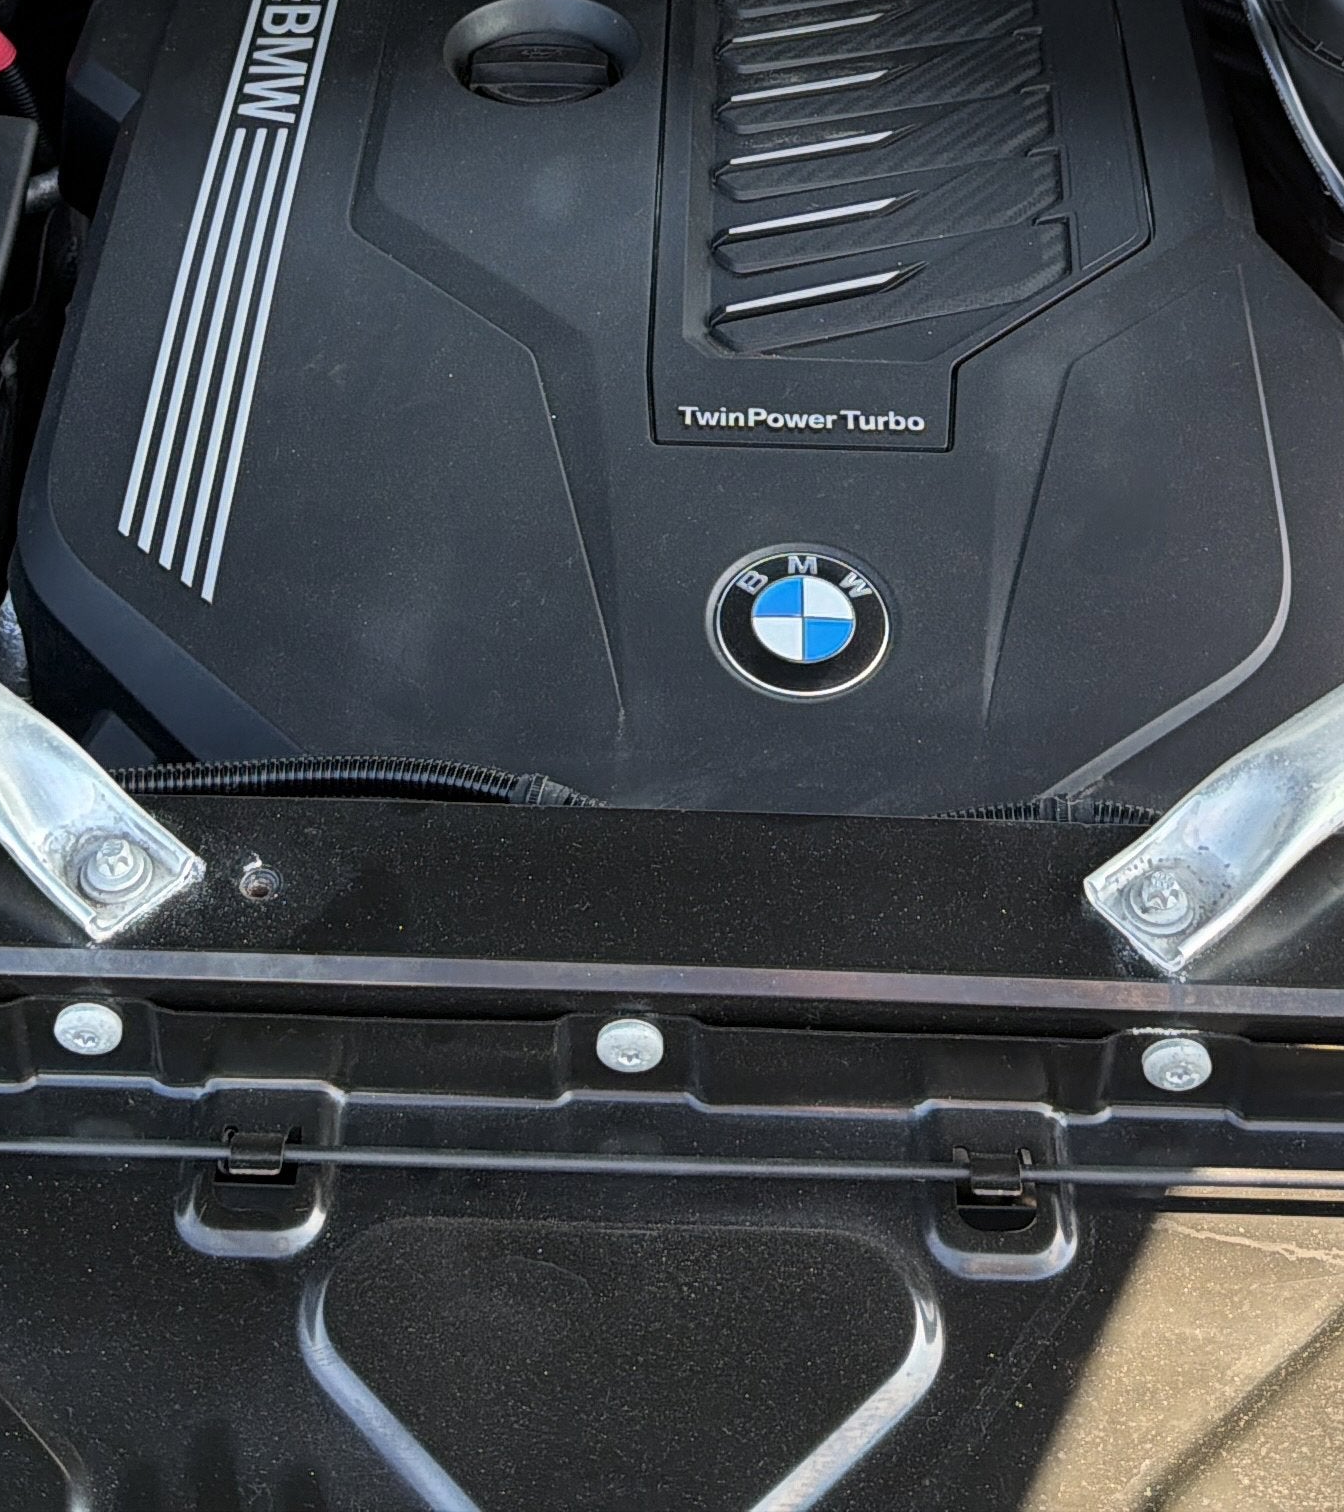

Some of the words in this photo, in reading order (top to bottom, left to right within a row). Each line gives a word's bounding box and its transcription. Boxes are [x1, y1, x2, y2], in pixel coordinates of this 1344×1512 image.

[237, 5, 322, 124] BMW
[678, 406, 837, 429] TwinPower
[840, 410, 925, 431] Turbo
[736, 555, 872, 598] BMW
